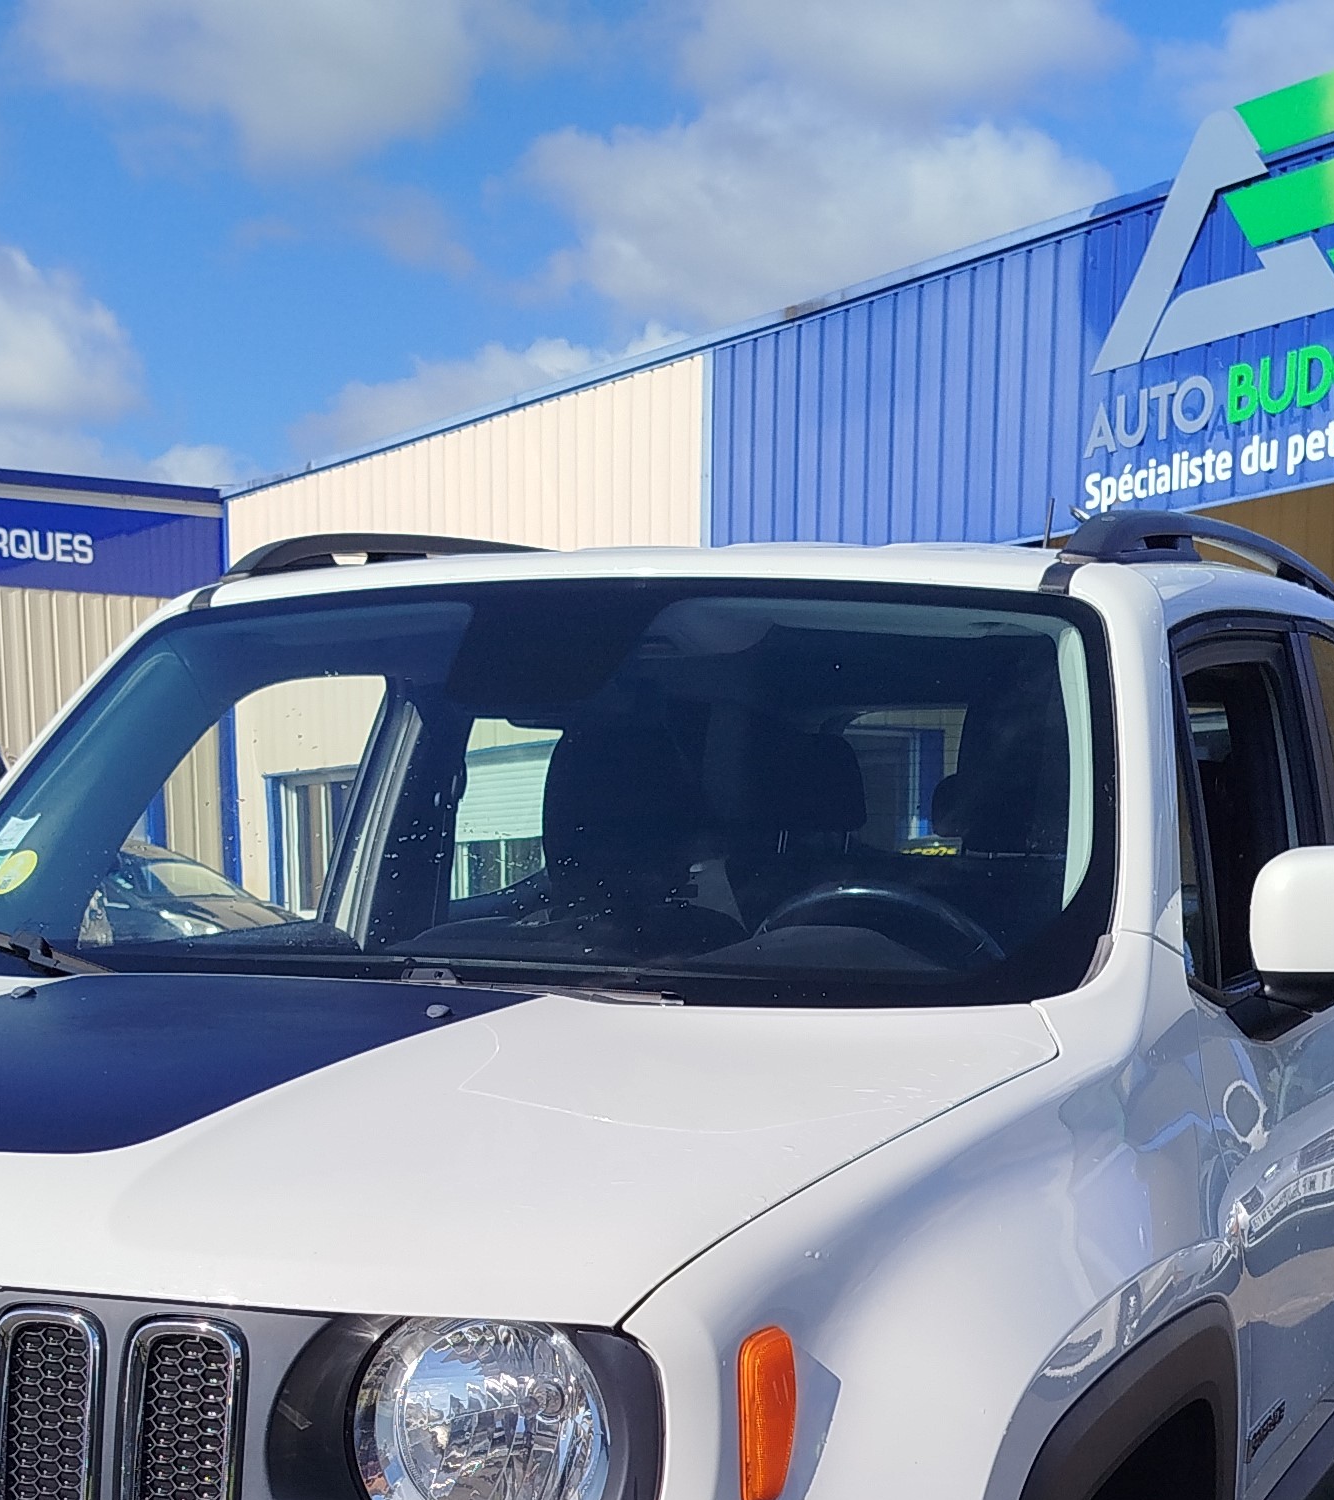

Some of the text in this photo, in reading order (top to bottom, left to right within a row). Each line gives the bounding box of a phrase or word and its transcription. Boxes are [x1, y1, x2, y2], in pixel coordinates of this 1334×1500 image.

[1083, 375, 1215, 459] AUTO
[1084, 449, 1233, 512] Spécialiste
[1240, 434, 1278, 476] du
